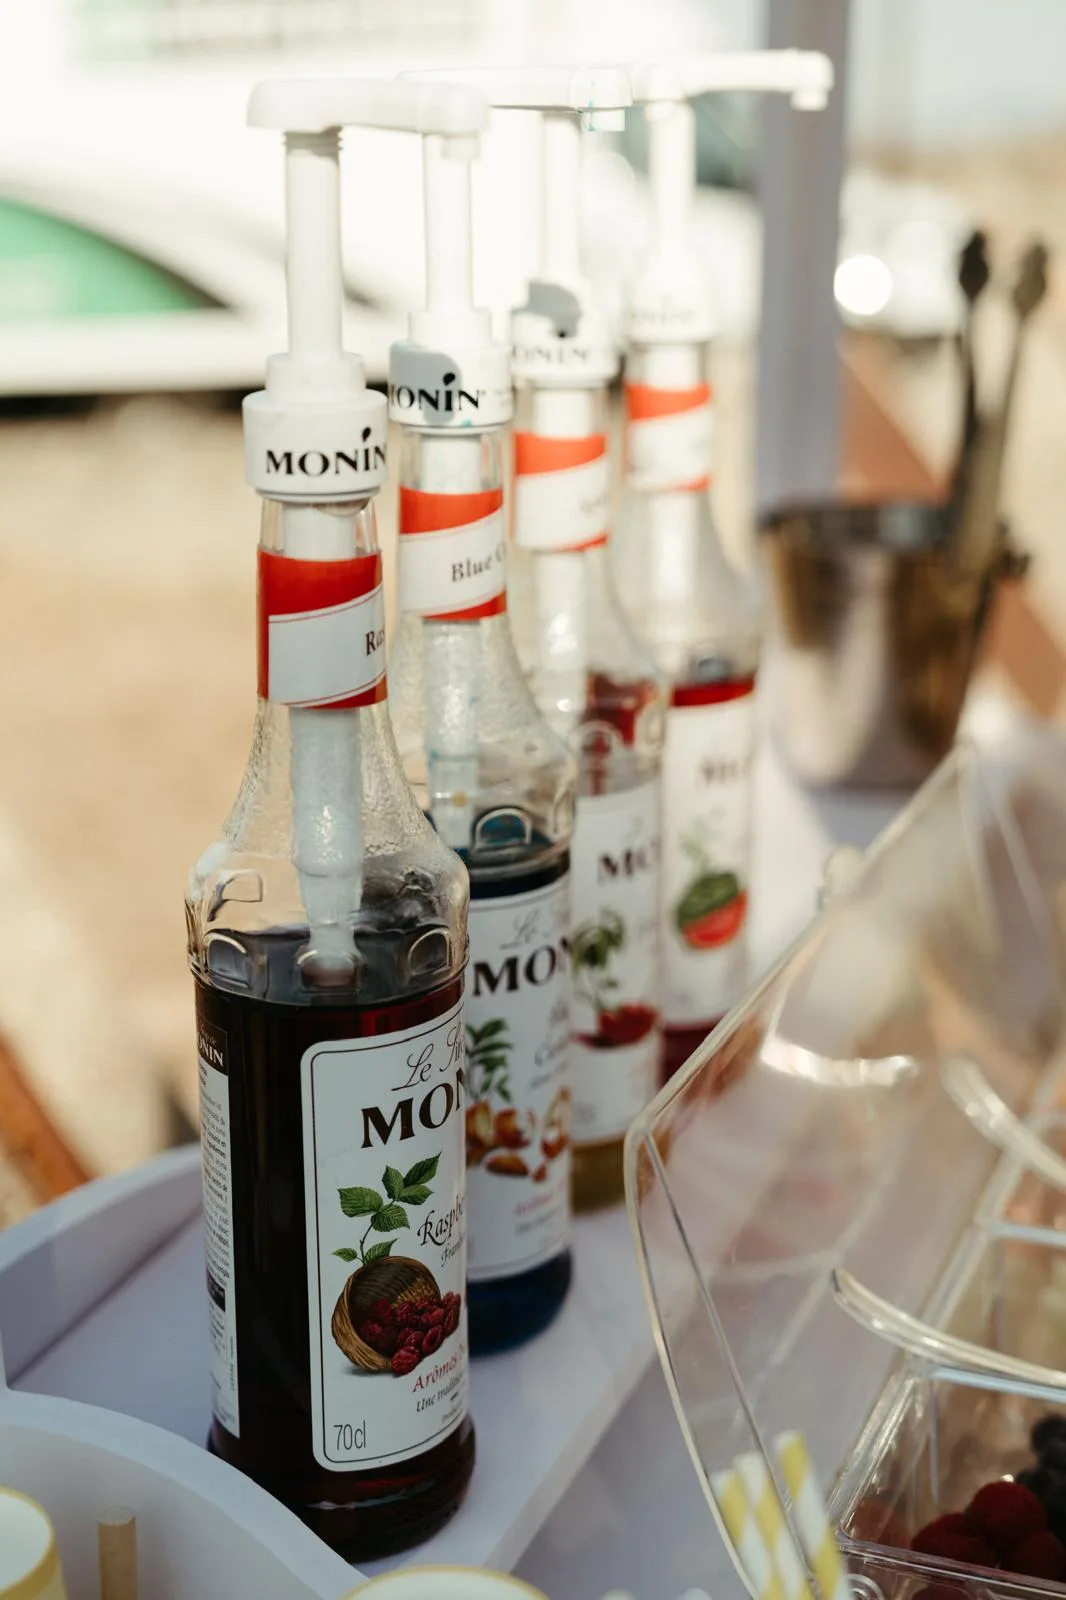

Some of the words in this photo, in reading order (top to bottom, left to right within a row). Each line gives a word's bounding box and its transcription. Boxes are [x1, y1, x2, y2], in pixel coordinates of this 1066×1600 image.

[390, 372, 479, 412] ONIN
[265, 426, 386, 477] MONIN
[452, 558, 491, 582] Blue
[390, 1043, 434, 1091] Le
[333, 1420, 366, 1450] 70cl
